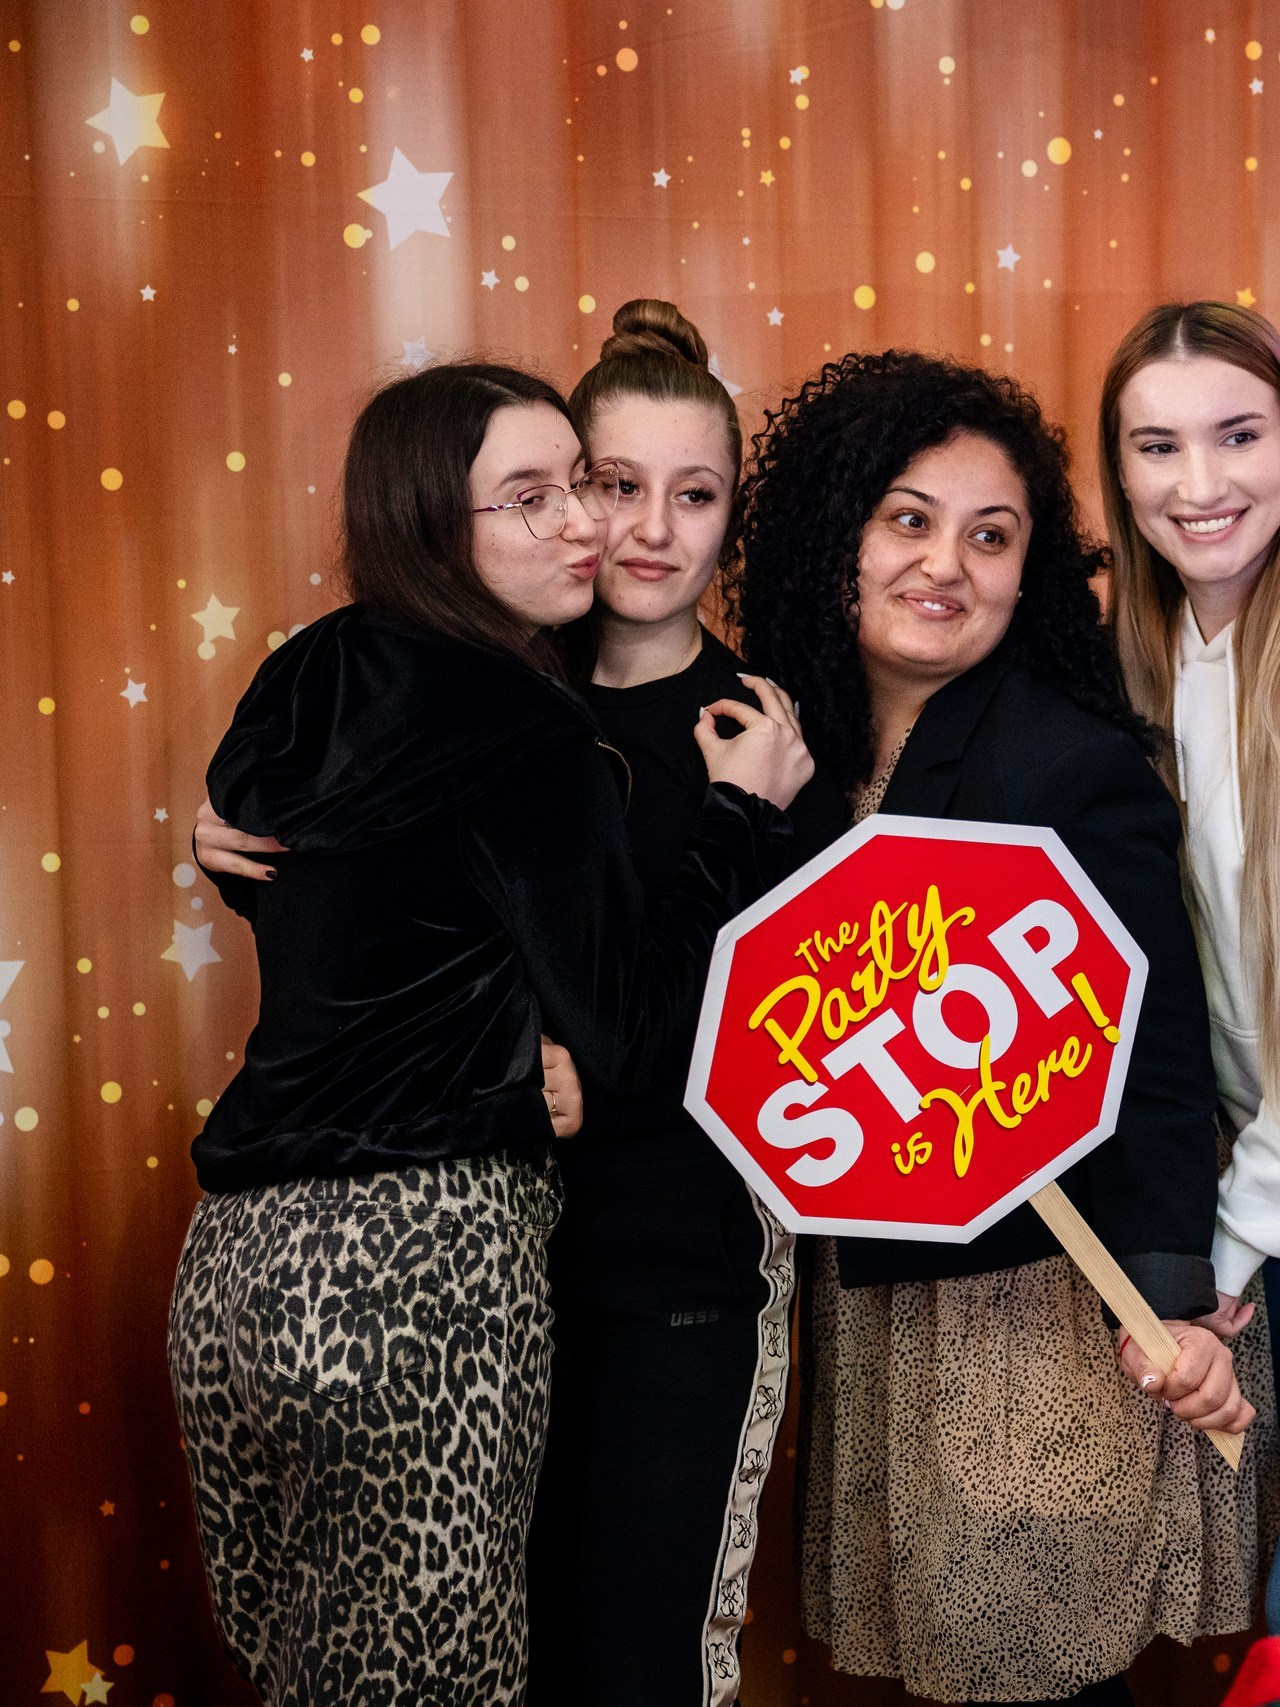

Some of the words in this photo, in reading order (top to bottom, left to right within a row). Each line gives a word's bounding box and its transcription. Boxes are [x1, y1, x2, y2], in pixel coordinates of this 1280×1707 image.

[748, 884, 976, 1083] Party
[795, 921, 859, 973] The
[756, 899, 1079, 1187] STOP
[891, 1132, 933, 1175] is
